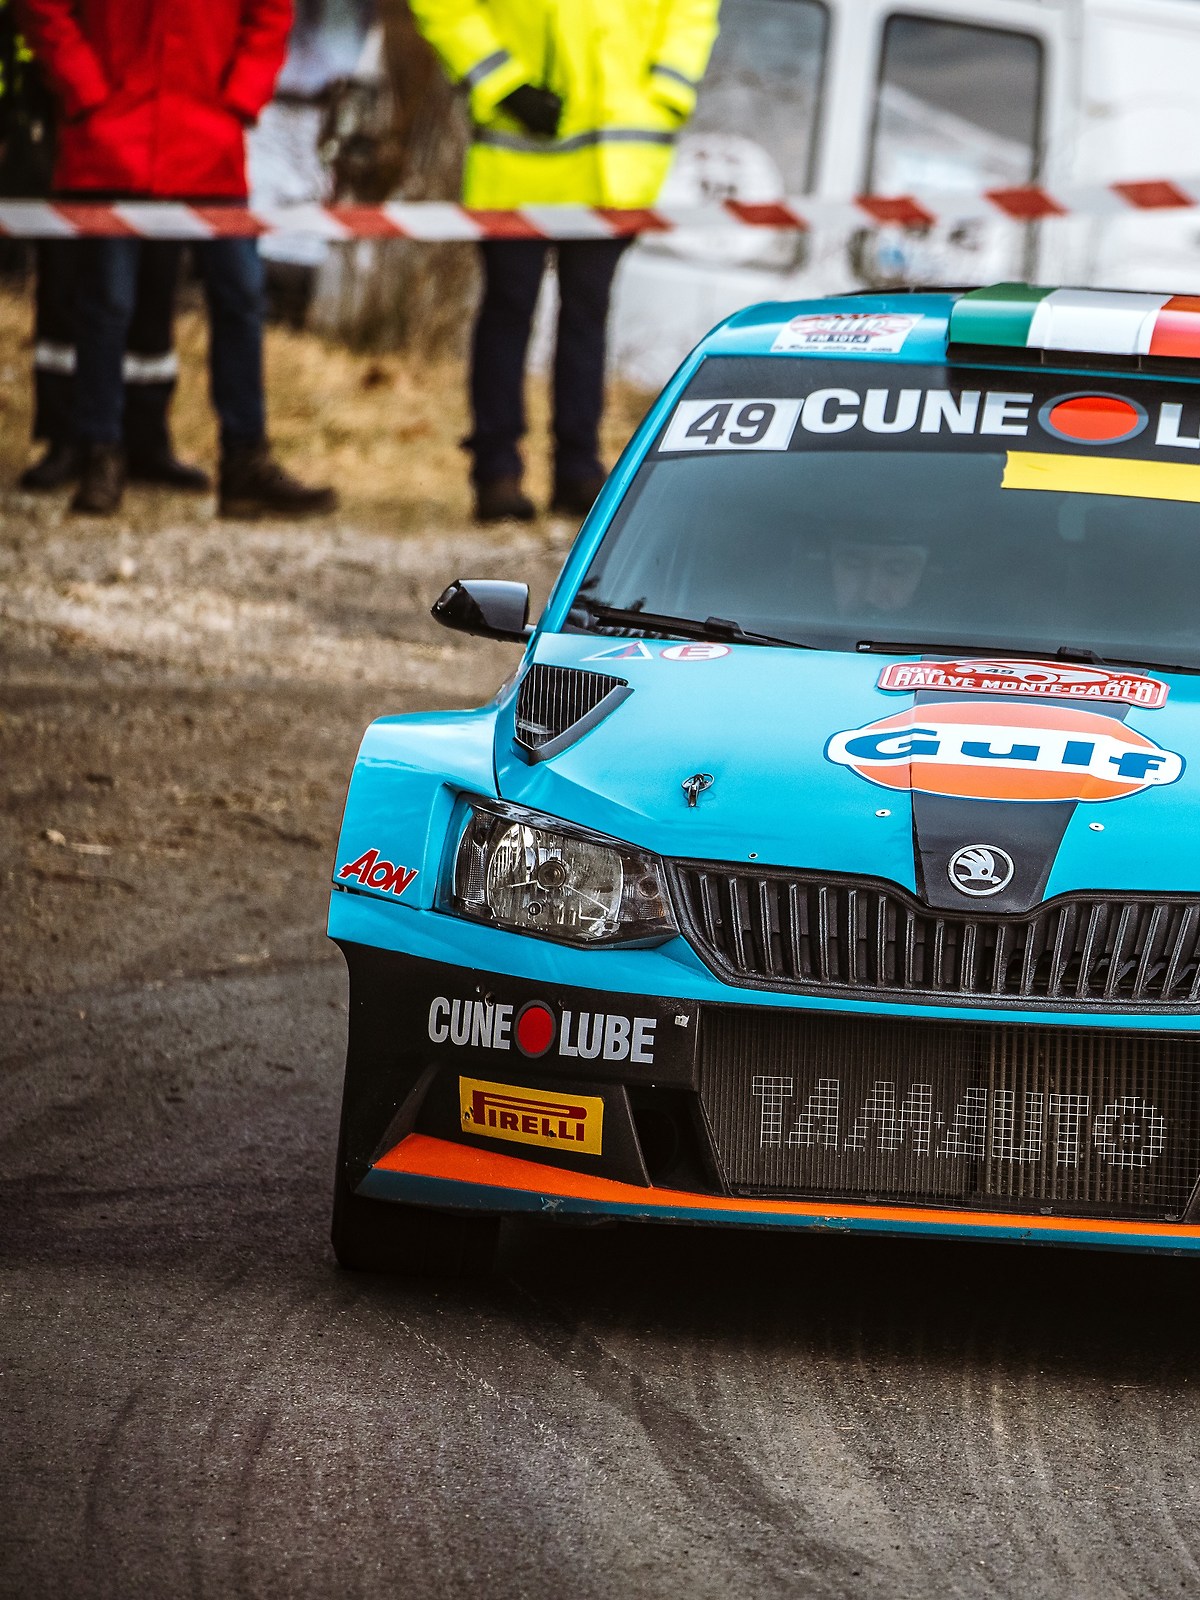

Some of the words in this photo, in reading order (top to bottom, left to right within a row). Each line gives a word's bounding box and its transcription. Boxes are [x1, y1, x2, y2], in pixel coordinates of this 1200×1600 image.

[685, 403, 776, 445] 49
[801, 388, 1034, 436] CUNE
[893, 670, 975, 687] RALLYE
[981, 679, 1153, 703] MONTE-CARLO
[845, 727, 1166, 779] Gulf
[339, 848, 419, 895] AON
[428, 997, 514, 1050] CUNE
[558, 1010, 658, 1064] LUBE
[472, 1089, 588, 1142] PIRELLI
